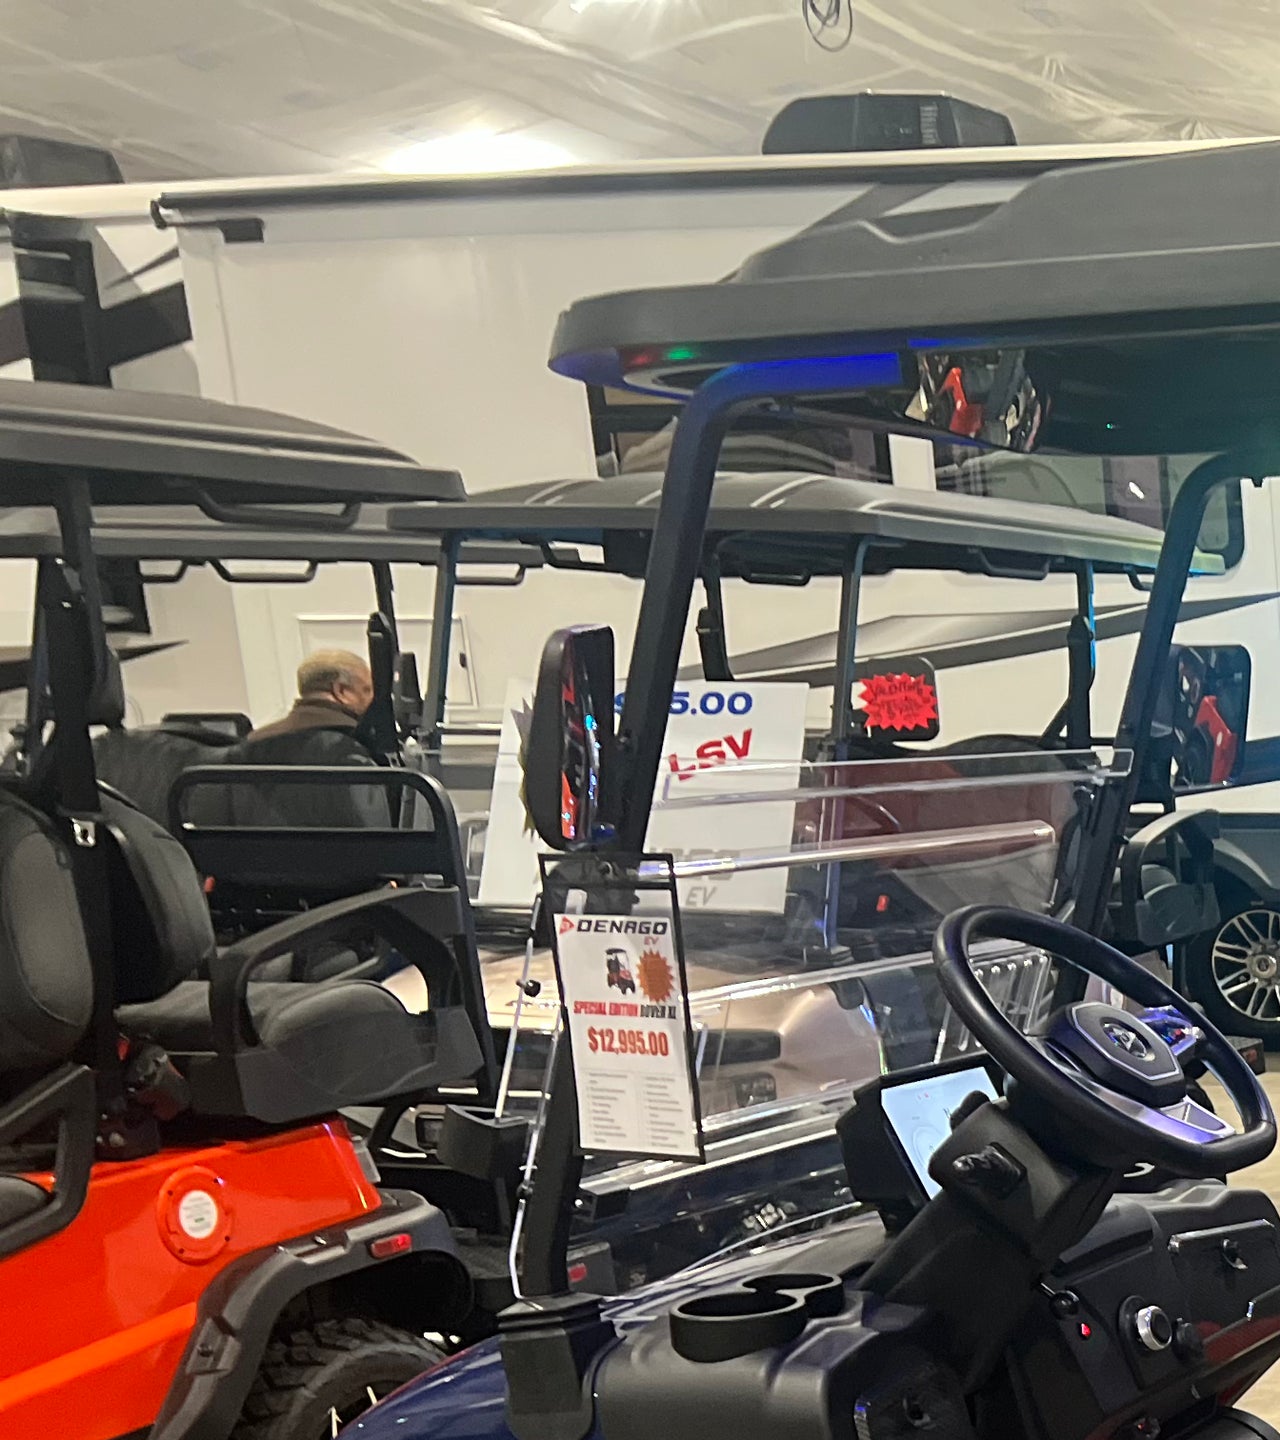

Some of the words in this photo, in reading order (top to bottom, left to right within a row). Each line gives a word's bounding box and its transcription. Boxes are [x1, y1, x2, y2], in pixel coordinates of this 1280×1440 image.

[669, 728, 754, 781] LSV
[576, 918, 668, 934] DENAGO
[587, 1026, 669, 1057] $12,995.00
